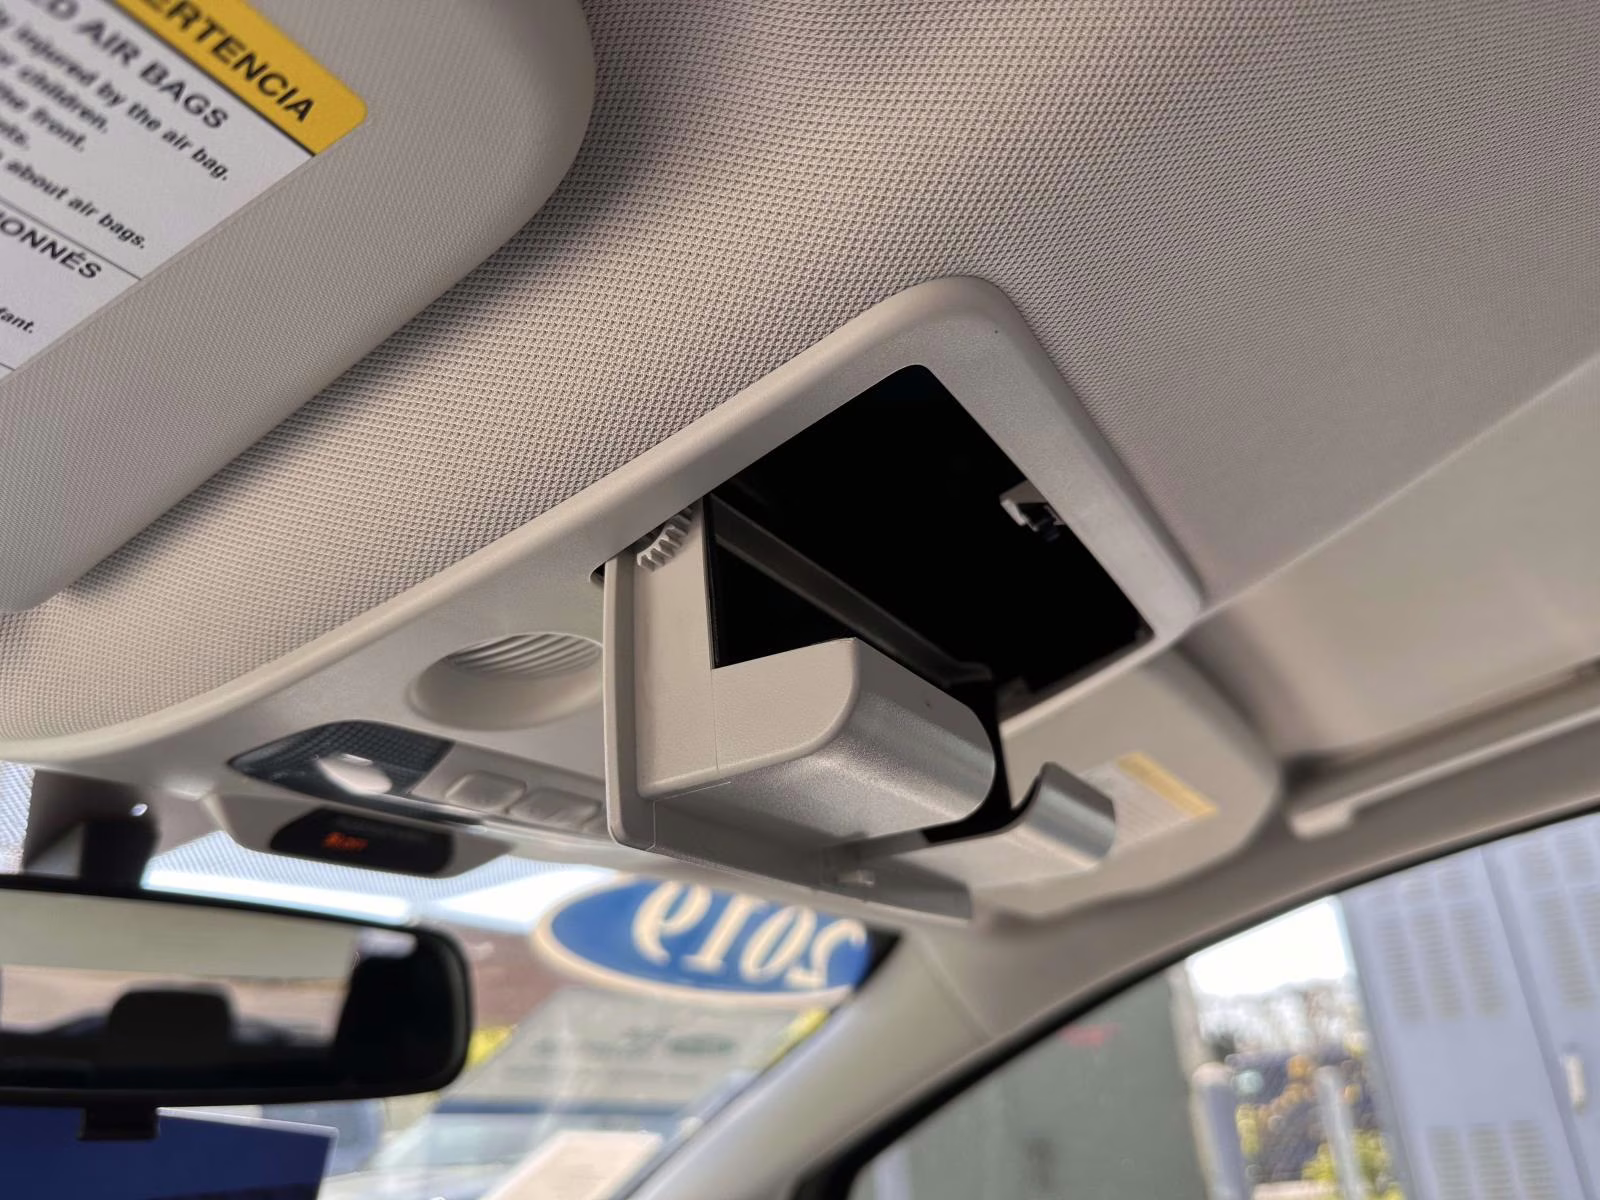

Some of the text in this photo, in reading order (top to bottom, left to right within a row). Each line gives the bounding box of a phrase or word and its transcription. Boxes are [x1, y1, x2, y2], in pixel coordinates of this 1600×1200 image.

[17, 24, 99, 87] injured
[97, 81, 126, 107] by
[126, 102, 162, 132] the
[161, 130, 194, 152] air
[191, 147, 230, 181] bag.
[18, 65, 108, 134] children.
[75, 20, 141, 67] AIR
[139, 61, 229, 129] BAGS
[31, 106, 87, 152] front.
[5, 161, 146, 249] about air bags.
